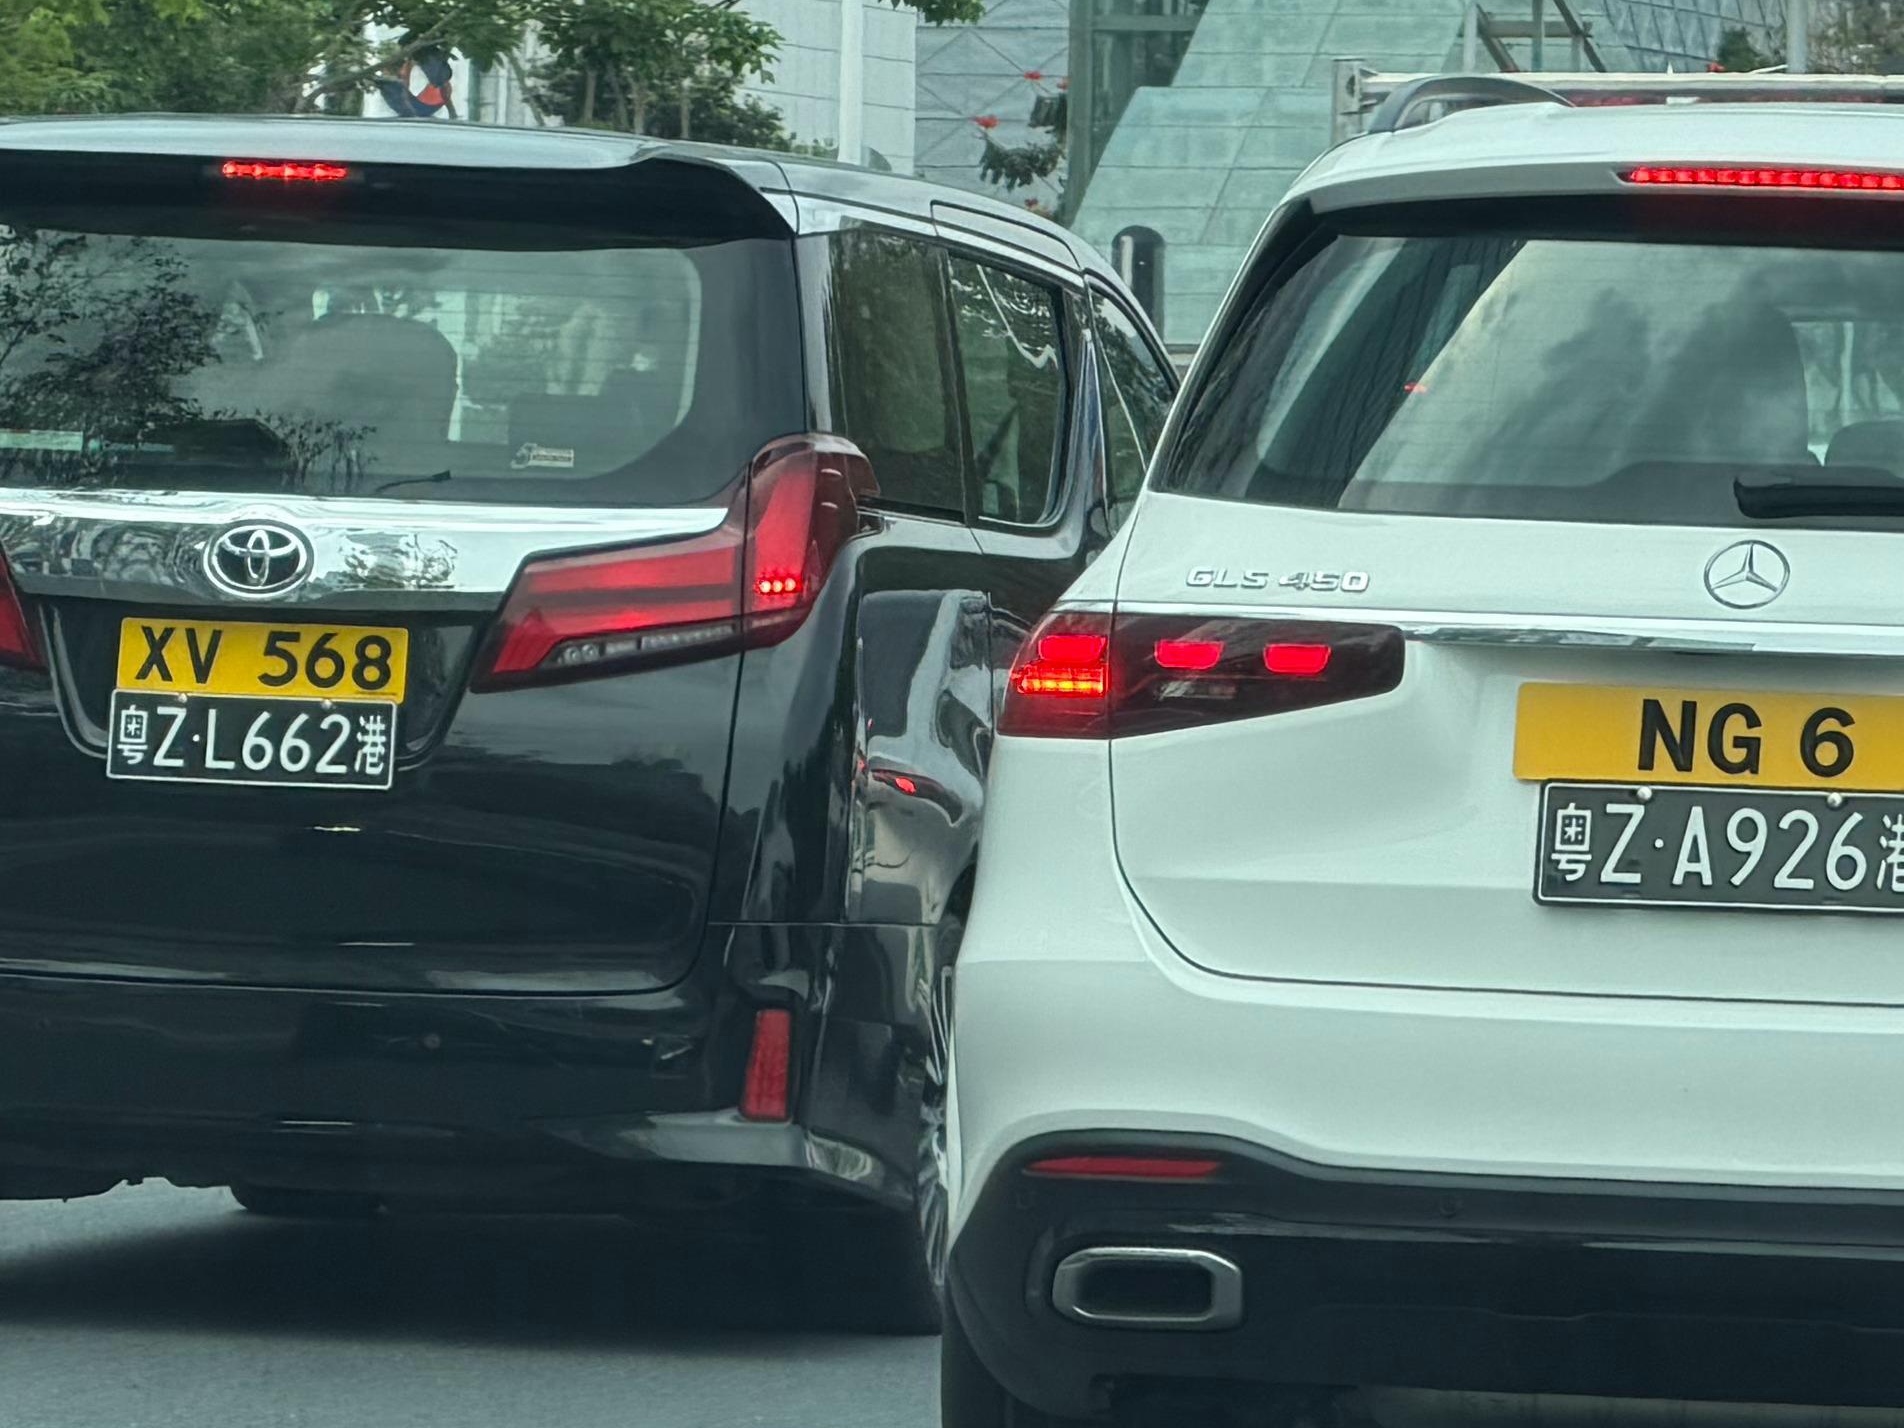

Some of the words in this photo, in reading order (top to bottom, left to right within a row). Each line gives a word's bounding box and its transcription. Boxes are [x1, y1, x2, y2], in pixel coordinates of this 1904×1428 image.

[1186, 566, 1268, 589] GLS
[1278, 570, 1370, 593] 450
[135, 625, 223, 684] XV
[257, 630, 393, 691] 568
[1637, 698, 1763, 775] NG
[1799, 706, 1856, 778] 6
